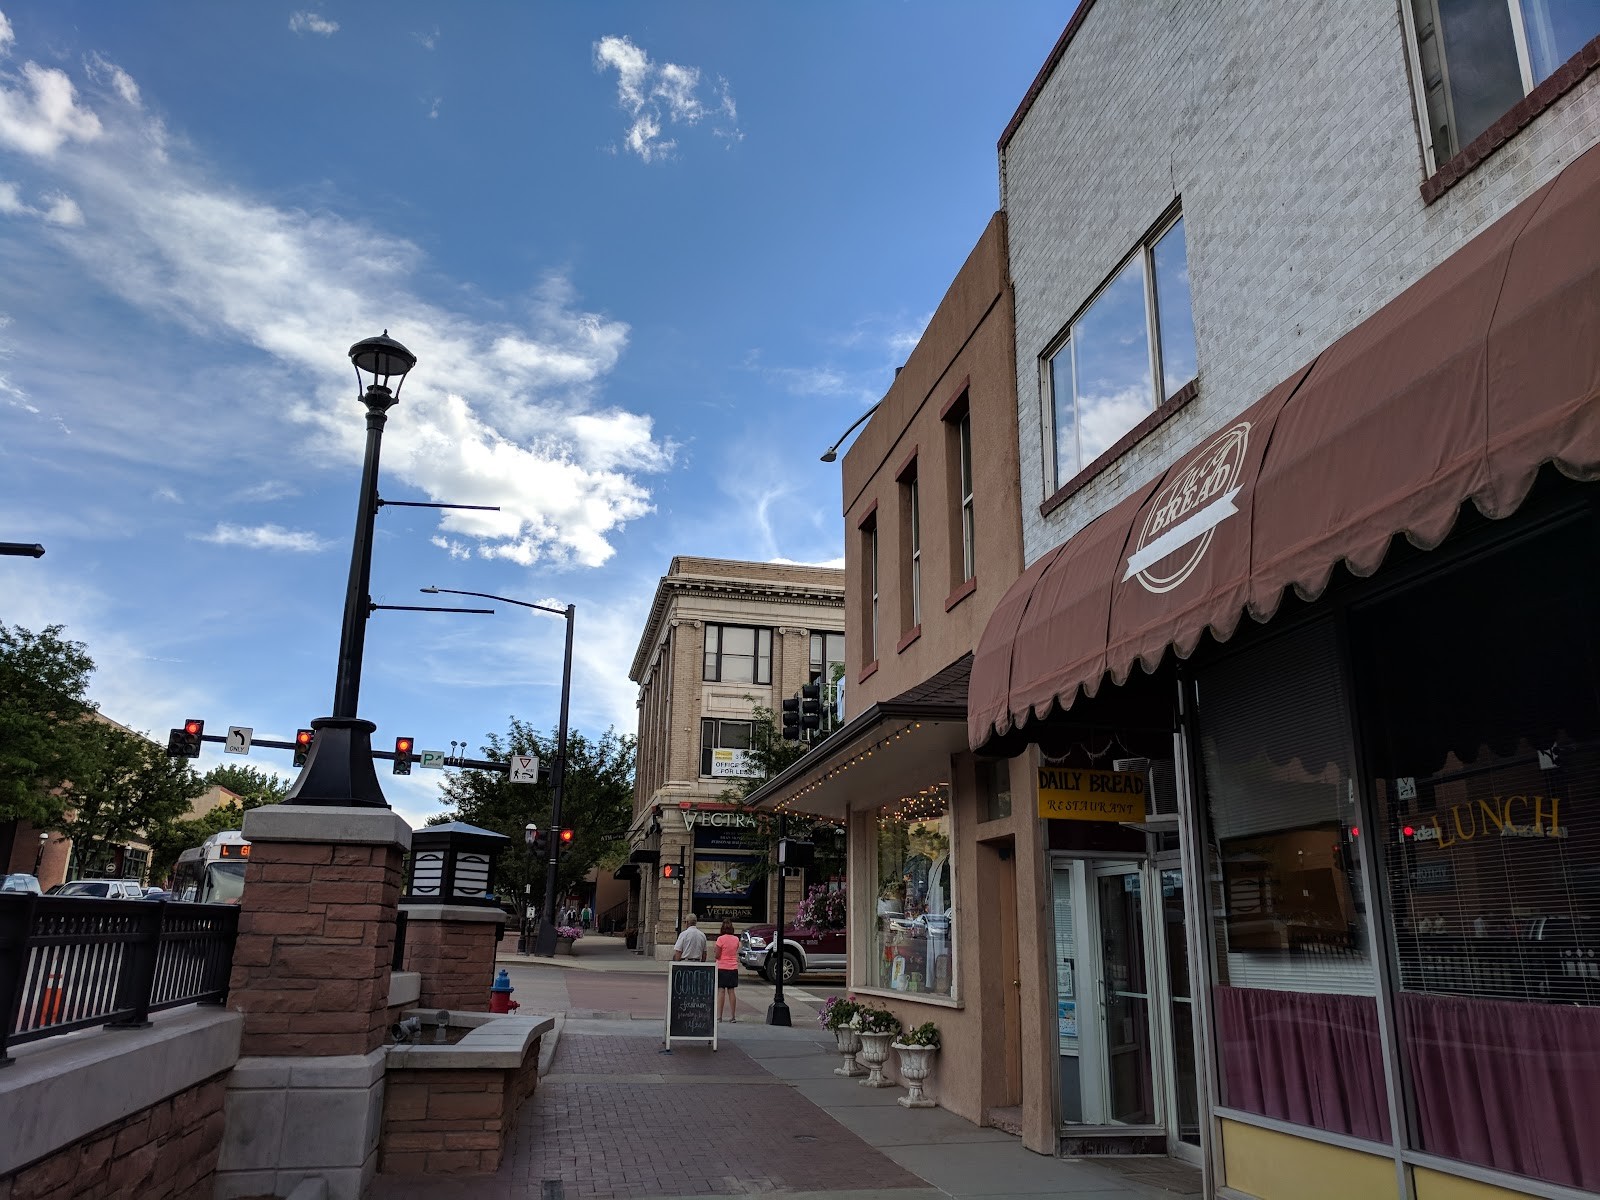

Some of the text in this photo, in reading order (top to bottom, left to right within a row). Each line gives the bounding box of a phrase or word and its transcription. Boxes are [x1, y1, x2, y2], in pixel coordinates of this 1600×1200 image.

[1148, 463, 1231, 537] BREAD
[1039, 770, 1144, 795] DAILY BREAD
[1047, 799, 1135, 815] RESTAURANT
[1431, 795, 1561, 850] LUNCH
[222, 845, 229, 856] L
